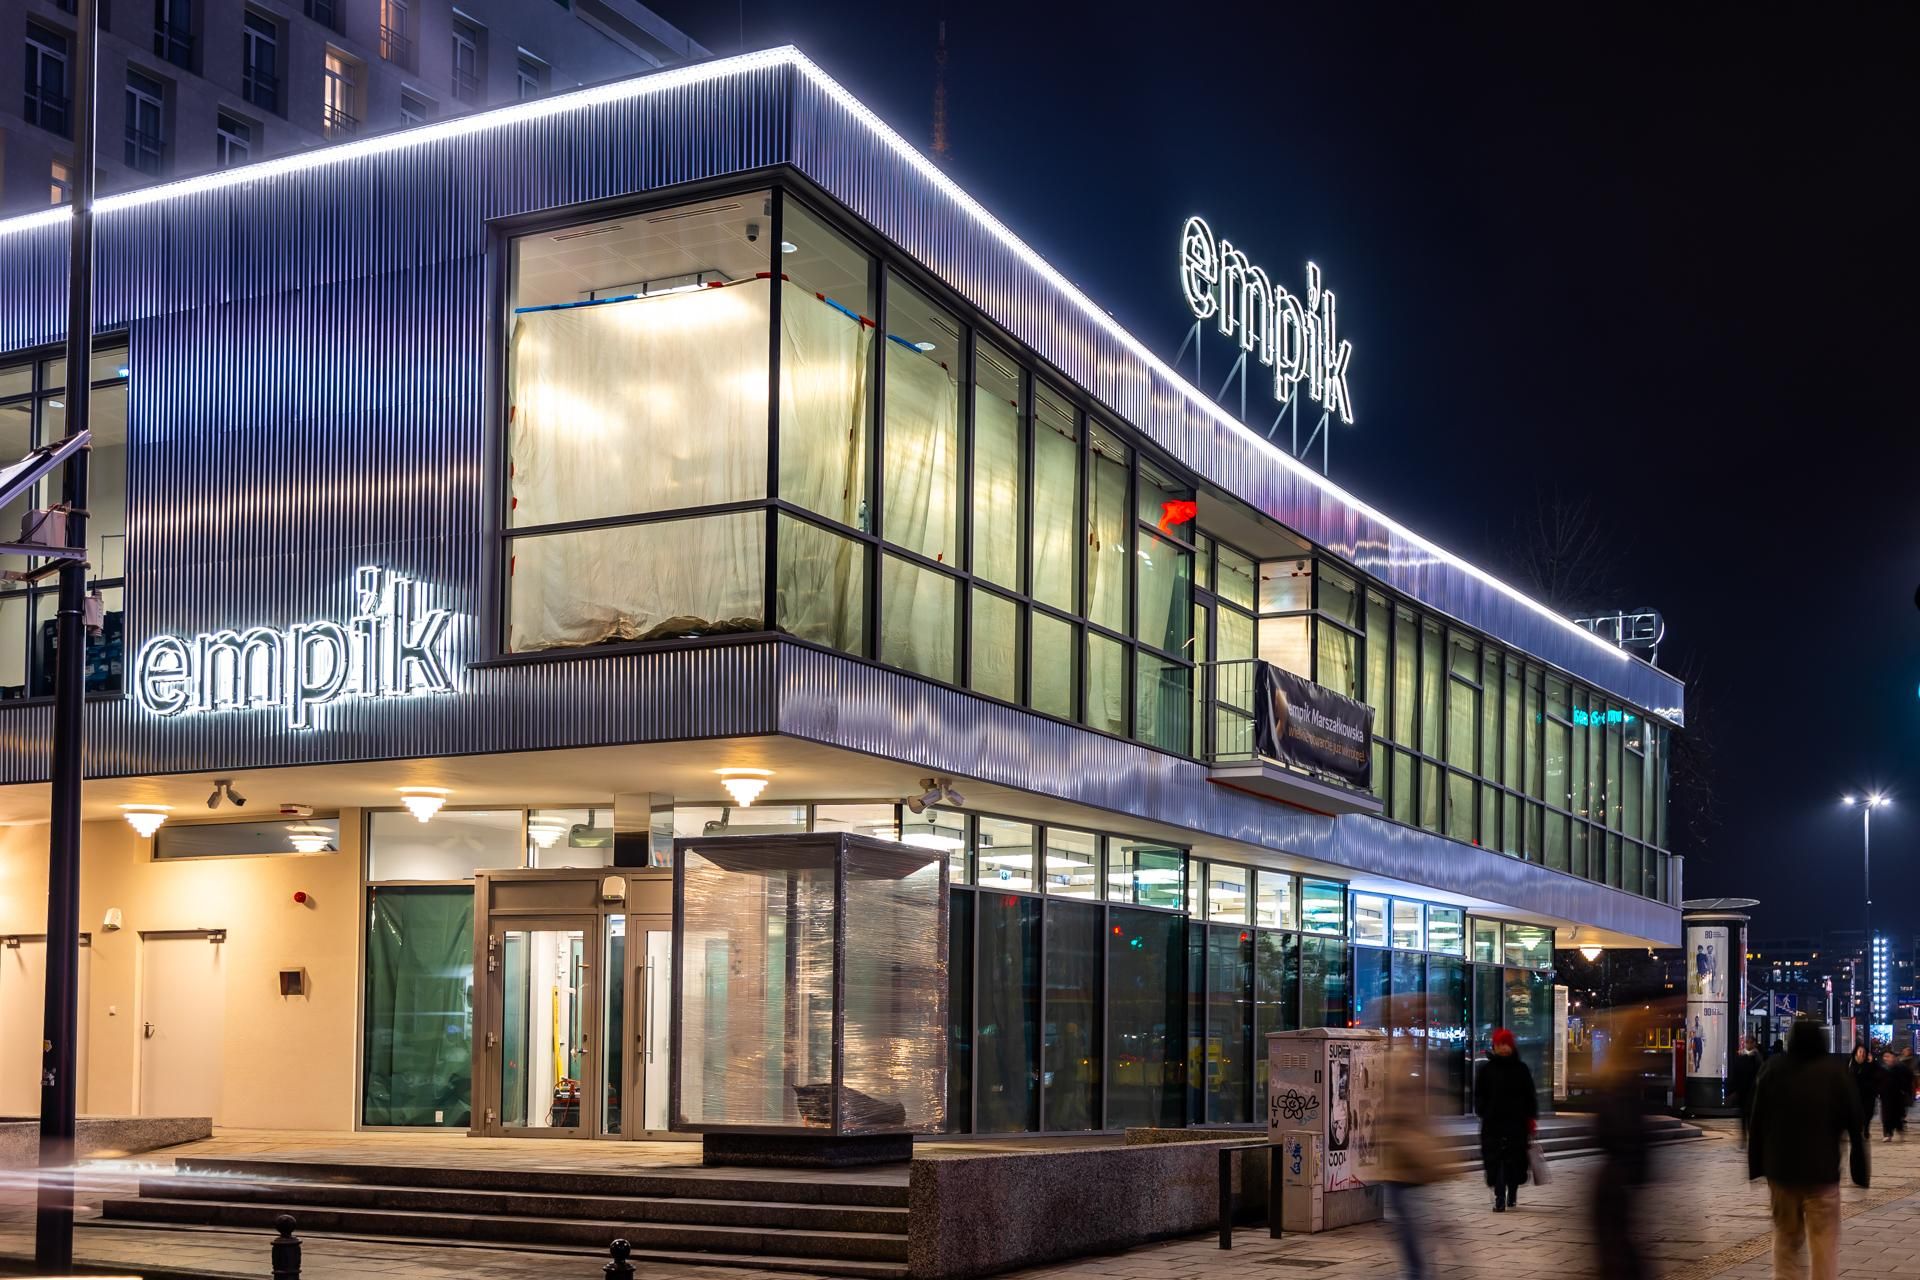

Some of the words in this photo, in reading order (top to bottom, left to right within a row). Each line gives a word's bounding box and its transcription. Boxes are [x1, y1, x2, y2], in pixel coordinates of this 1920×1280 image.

[1180, 216, 1354, 424] empik
[137, 565, 460, 730] empik
[1288, 701, 1311, 722] empik
[1312, 708, 1364, 743] Marszałkowska
